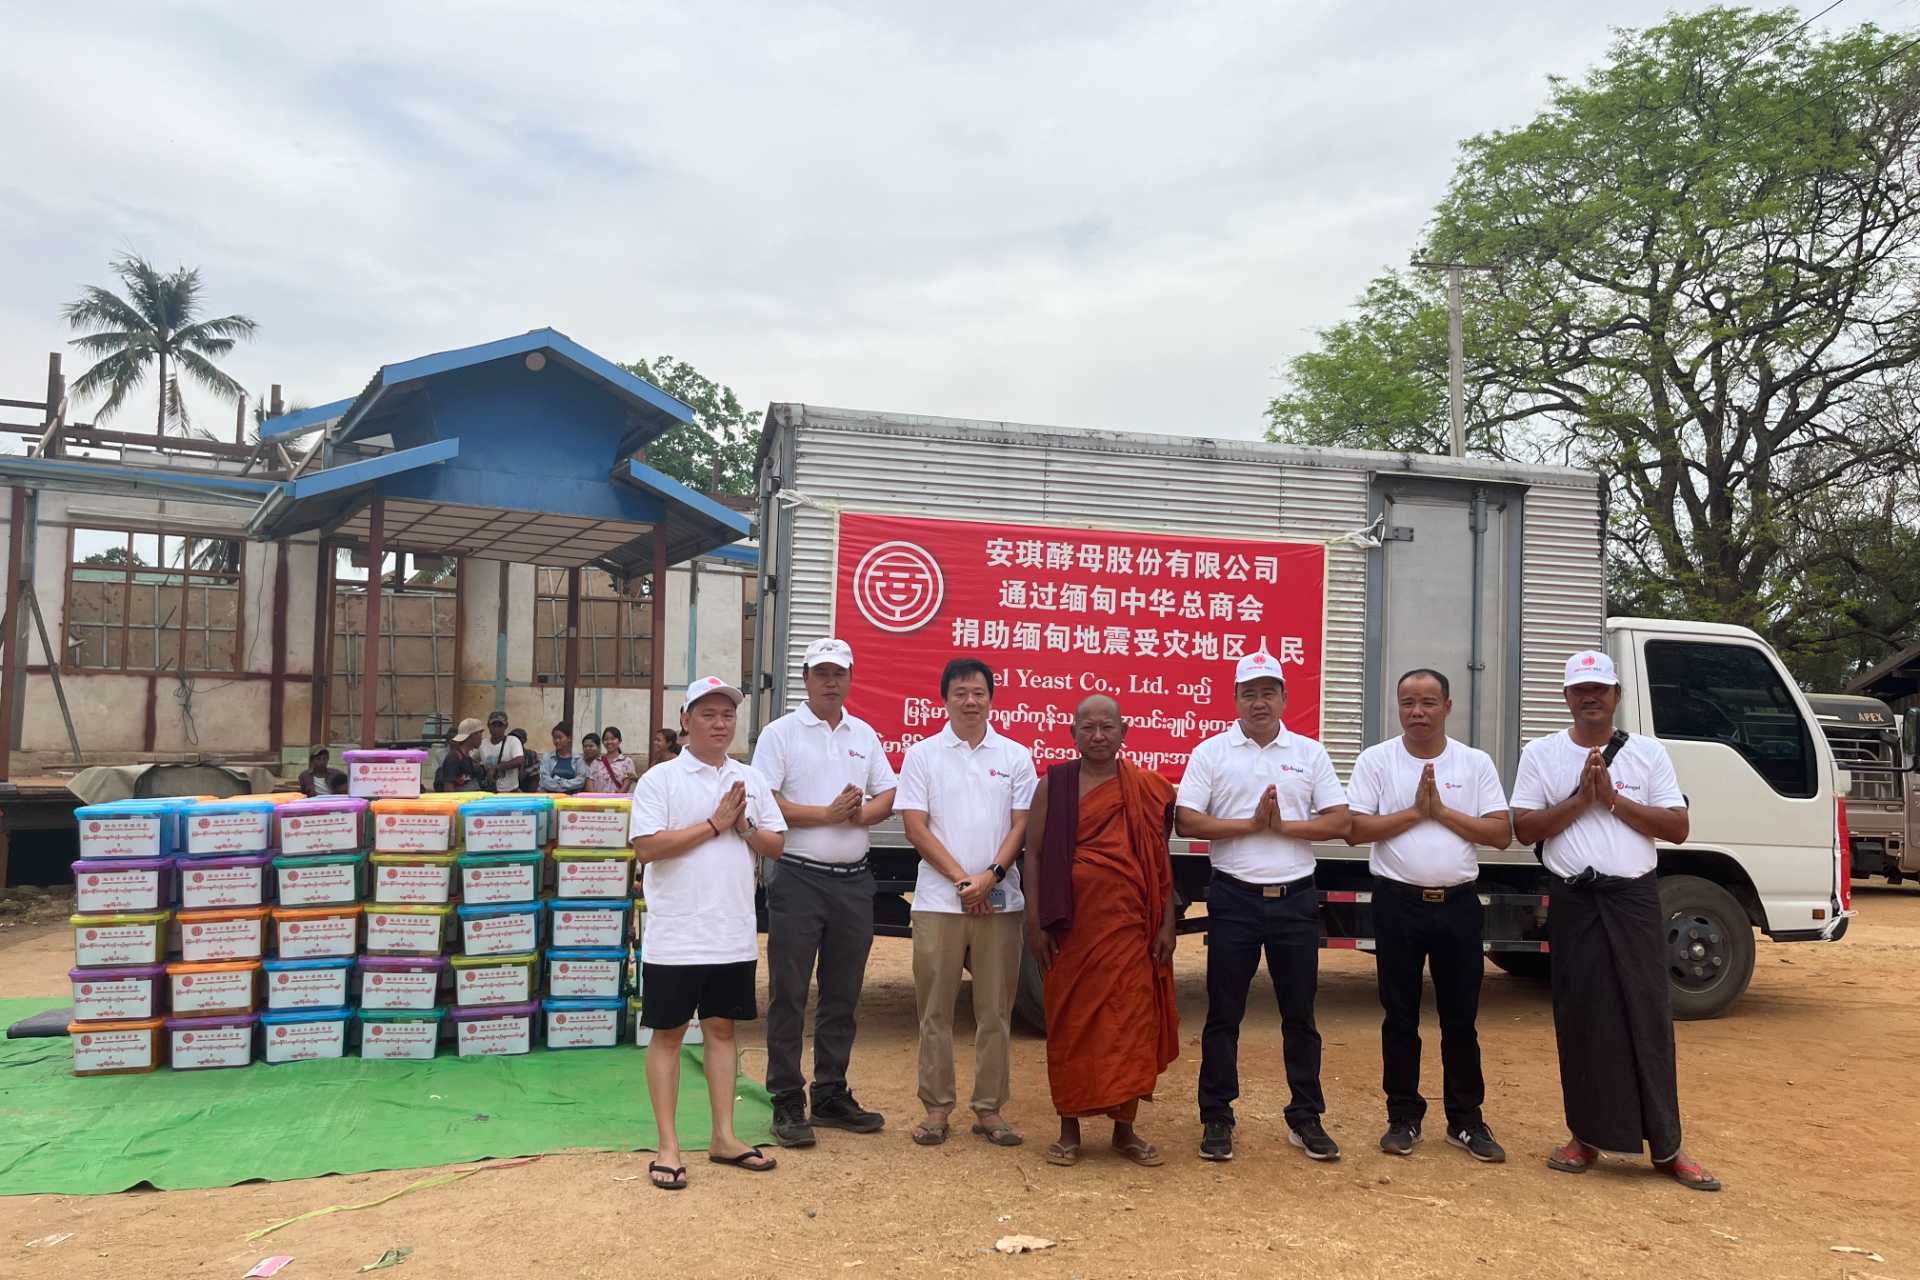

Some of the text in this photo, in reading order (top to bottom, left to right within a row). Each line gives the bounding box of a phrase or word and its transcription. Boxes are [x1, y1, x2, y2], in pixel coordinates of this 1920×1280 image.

[986, 537, 1279, 584] 安琪酵母股份有限公司
[998, 579, 1264, 623] 通过缅甸中华总商会
[952, 618, 1305, 665] 捐助缅甸地震受灾地区人民
[1016, 669, 1073, 690] Yeast
[1080, 672, 1121, 695] Co.,
[1129, 675, 1169, 695] Ltd.
[1177, 677, 1212, 704] သည်
[1858, 712, 1884, 722] APEX
[1458, 1130, 1472, 1145] N
